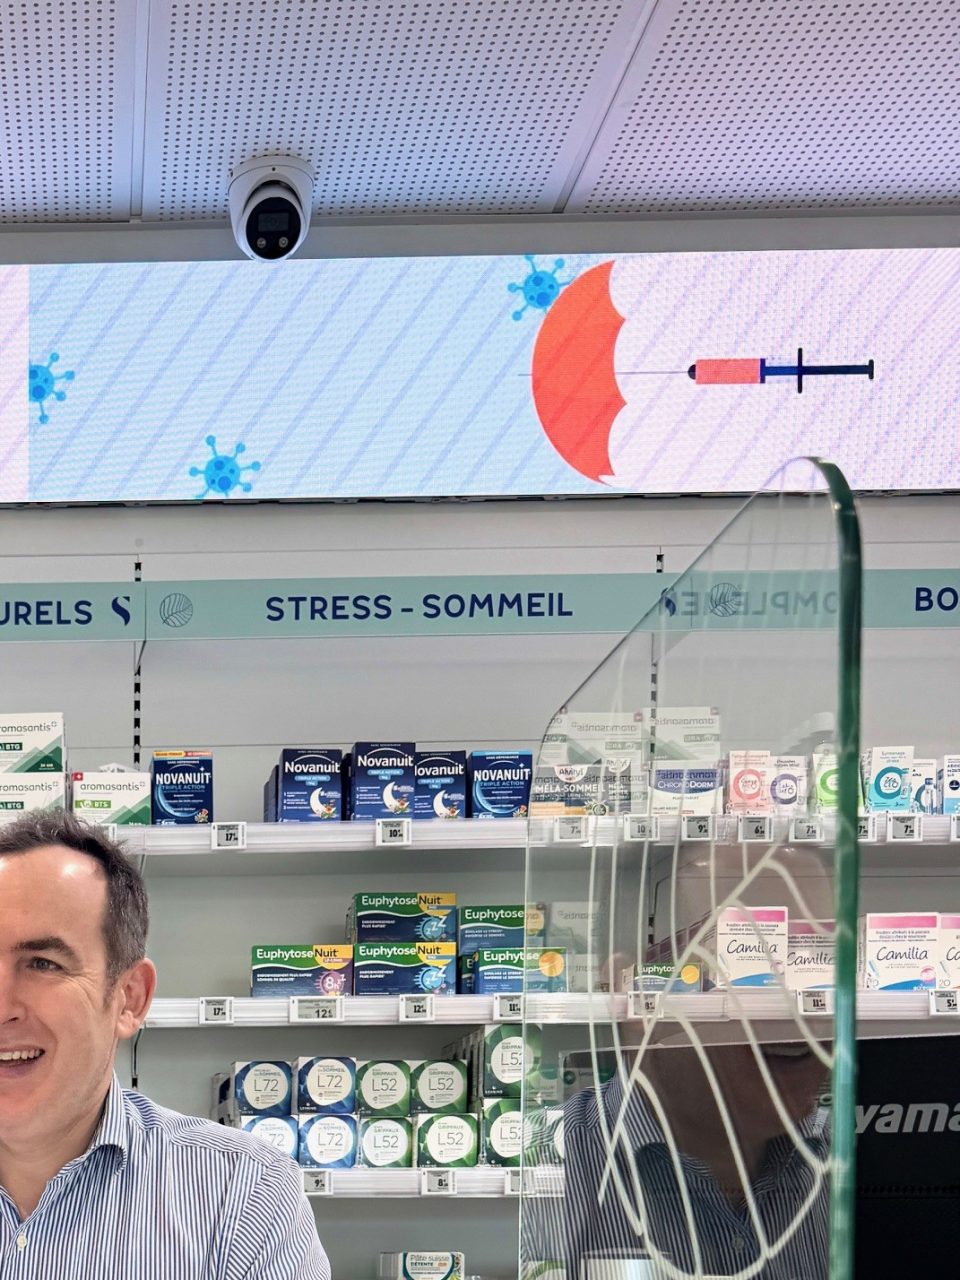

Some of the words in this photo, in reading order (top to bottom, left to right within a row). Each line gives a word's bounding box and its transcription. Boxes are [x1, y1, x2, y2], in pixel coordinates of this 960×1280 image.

[914, 586, 960, 612] BO
[265, 595, 392, 622] STRESS
[422, 592, 574, 619] SOMMEIL
[5, 743, 21, 751] BTG
[285, 761, 341, 773] Novanuit
[357, 754, 414, 767] Novanuit
[415, 763, 465, 775] ovanuit
[473, 768, 530, 782] NOVANUIT
[155, 772, 211, 785] NOVANUIT
[657, 780, 714, 788] CHRONDORM
[80, 782, 140, 792] aromasantis
[535, 782, 606, 793] MÉLA-SOMMEL
[6, 802, 22, 810] BTG
[465, 909, 524, 921] Euphytose
[727, 939, 779, 954] Camila
[876, 946, 929, 961] Camilia
[253, 1078, 279, 1092] L72
[317, 1074, 343, 1088] L72
[371, 1078, 398, 1092] L52
[428, 1077, 455, 1091] L52
[317, 1133, 344, 1146] L72
[373, 1135, 399, 1148] L52
[437, 1132, 464, 1146] L52
[410, 1253, 426, 1262] Pâte
[428, 1254, 450, 1262] suisse
